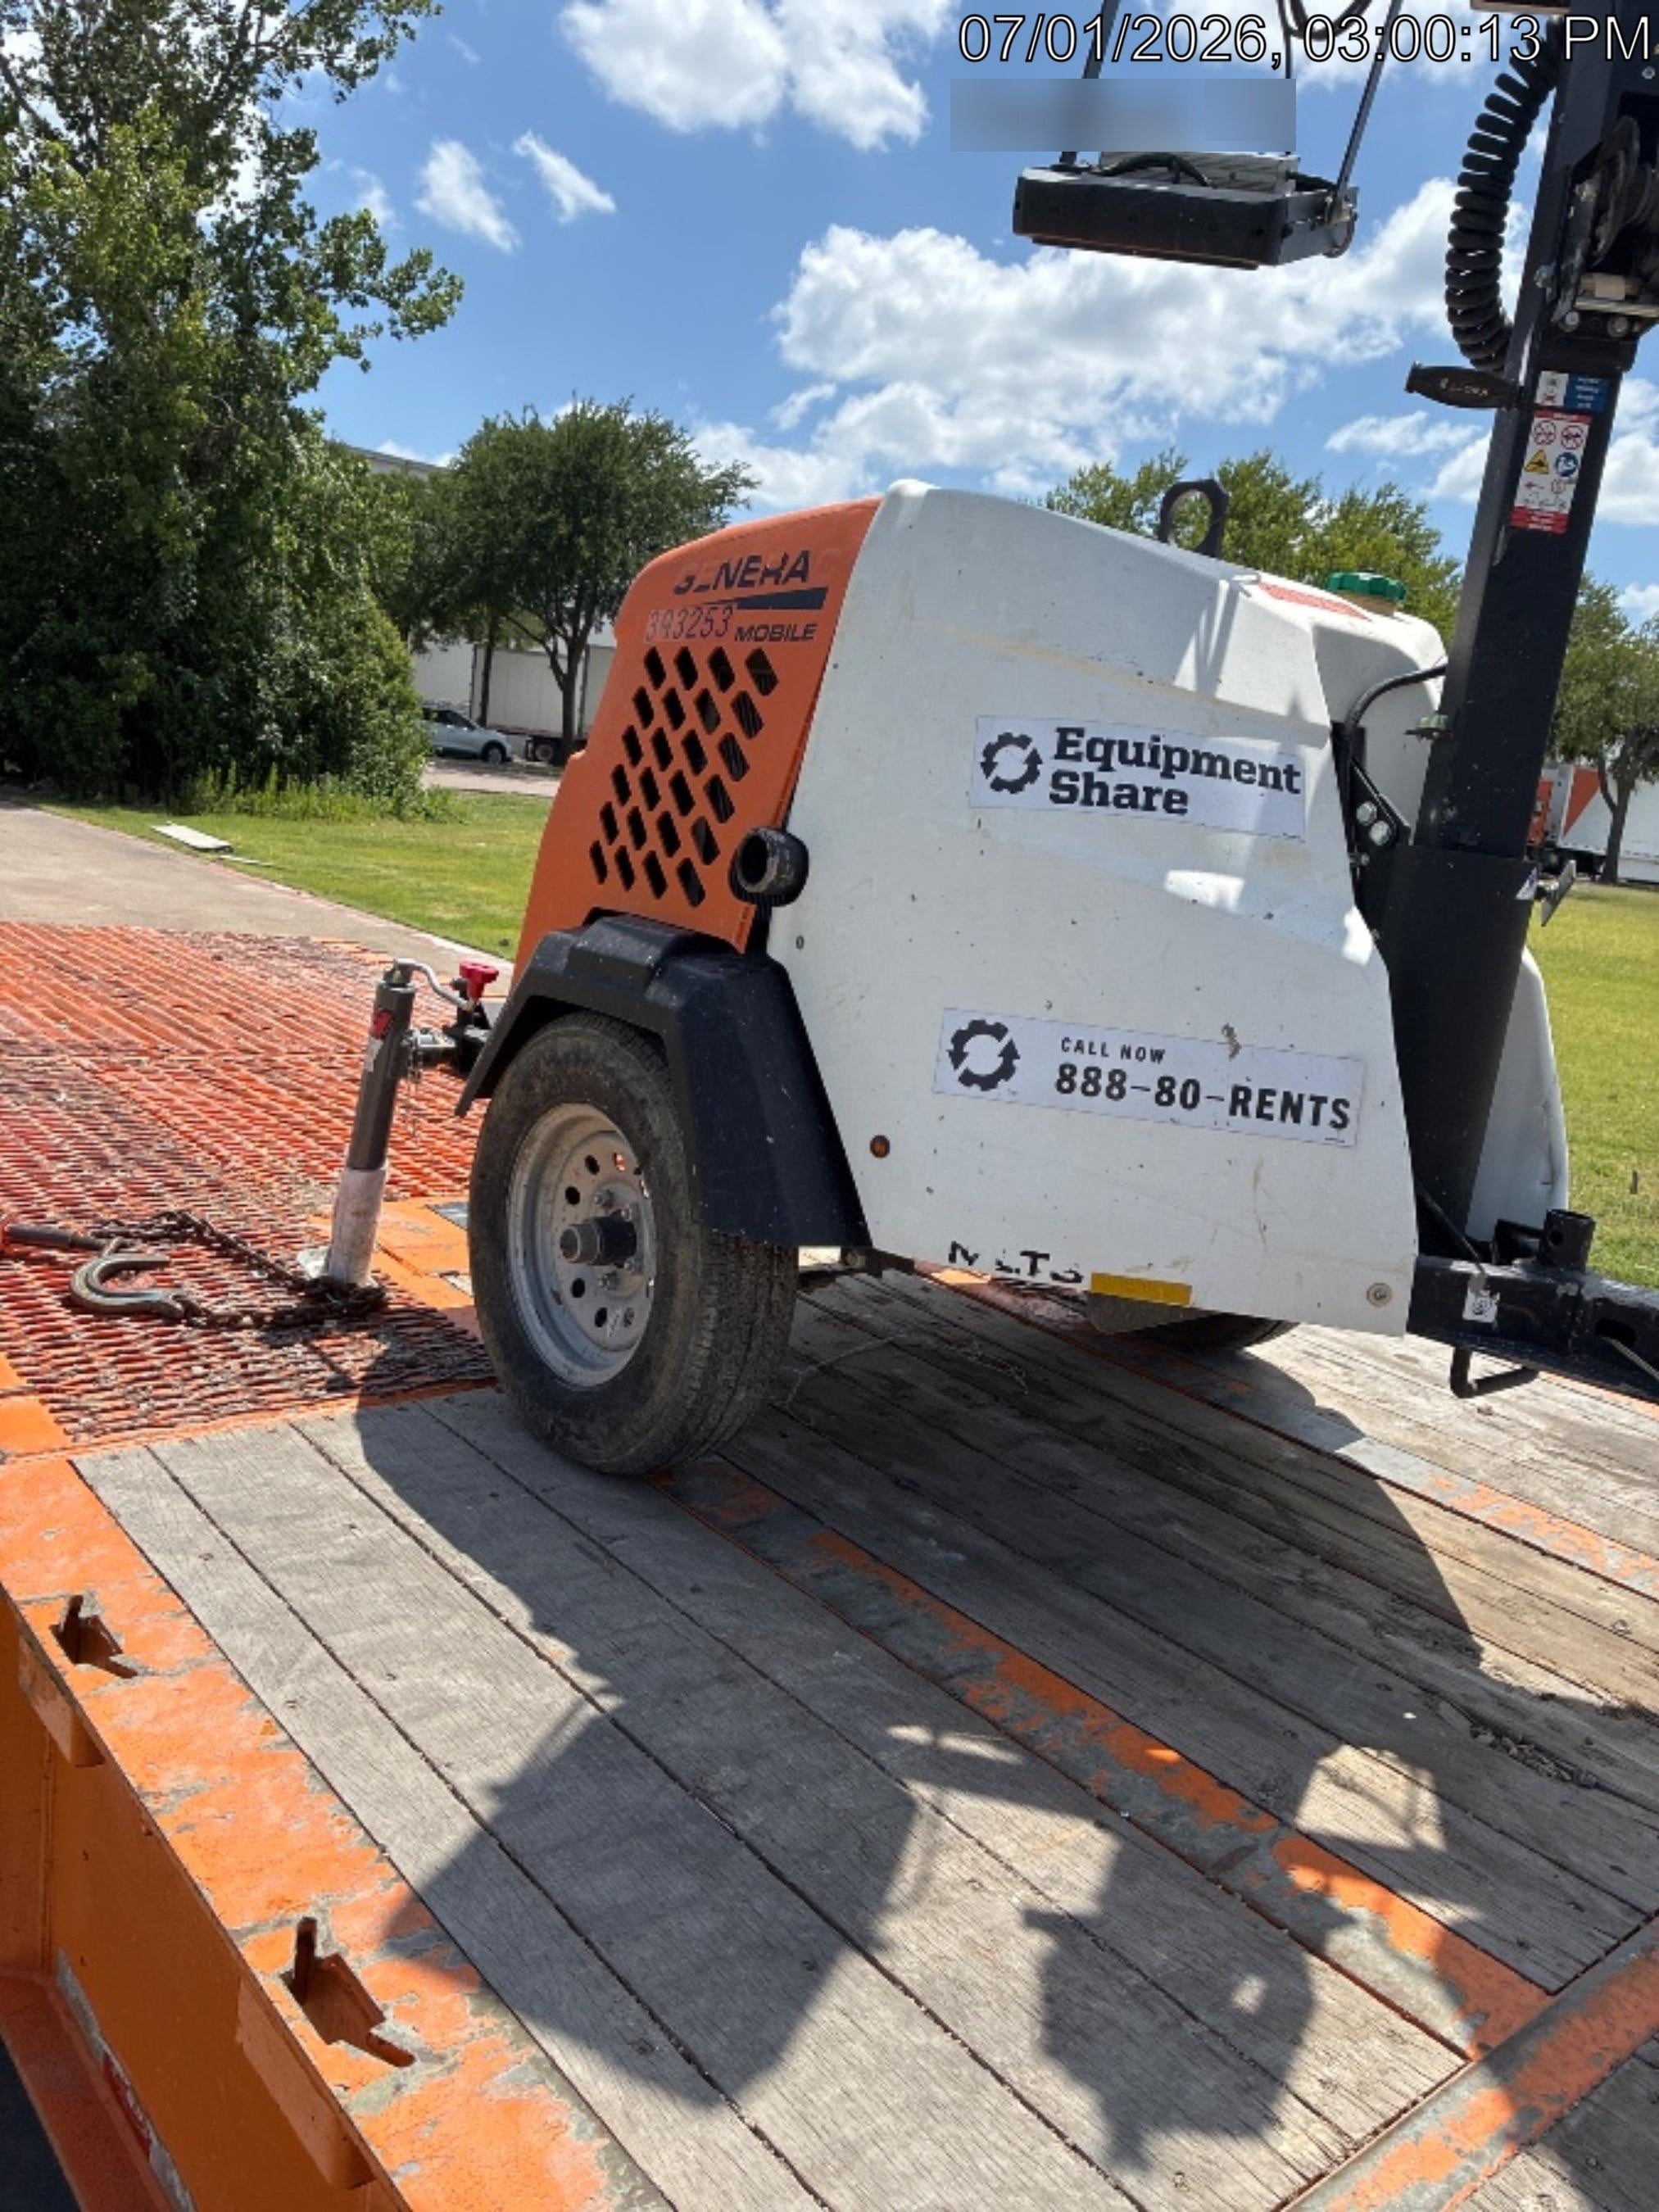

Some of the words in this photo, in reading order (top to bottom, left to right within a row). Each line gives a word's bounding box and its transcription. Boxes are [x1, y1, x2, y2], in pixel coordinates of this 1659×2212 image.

[734, 623, 818, 642] MOBILE
[1053, 727, 1302, 794] Equipment
[1049, 769, 1189, 815] Share
[1060, 1036, 1110, 1058] CALL
[1120, 1044, 1166, 1064] NOW
[1054, 1062, 1352, 1130] 888-80-RENTS
